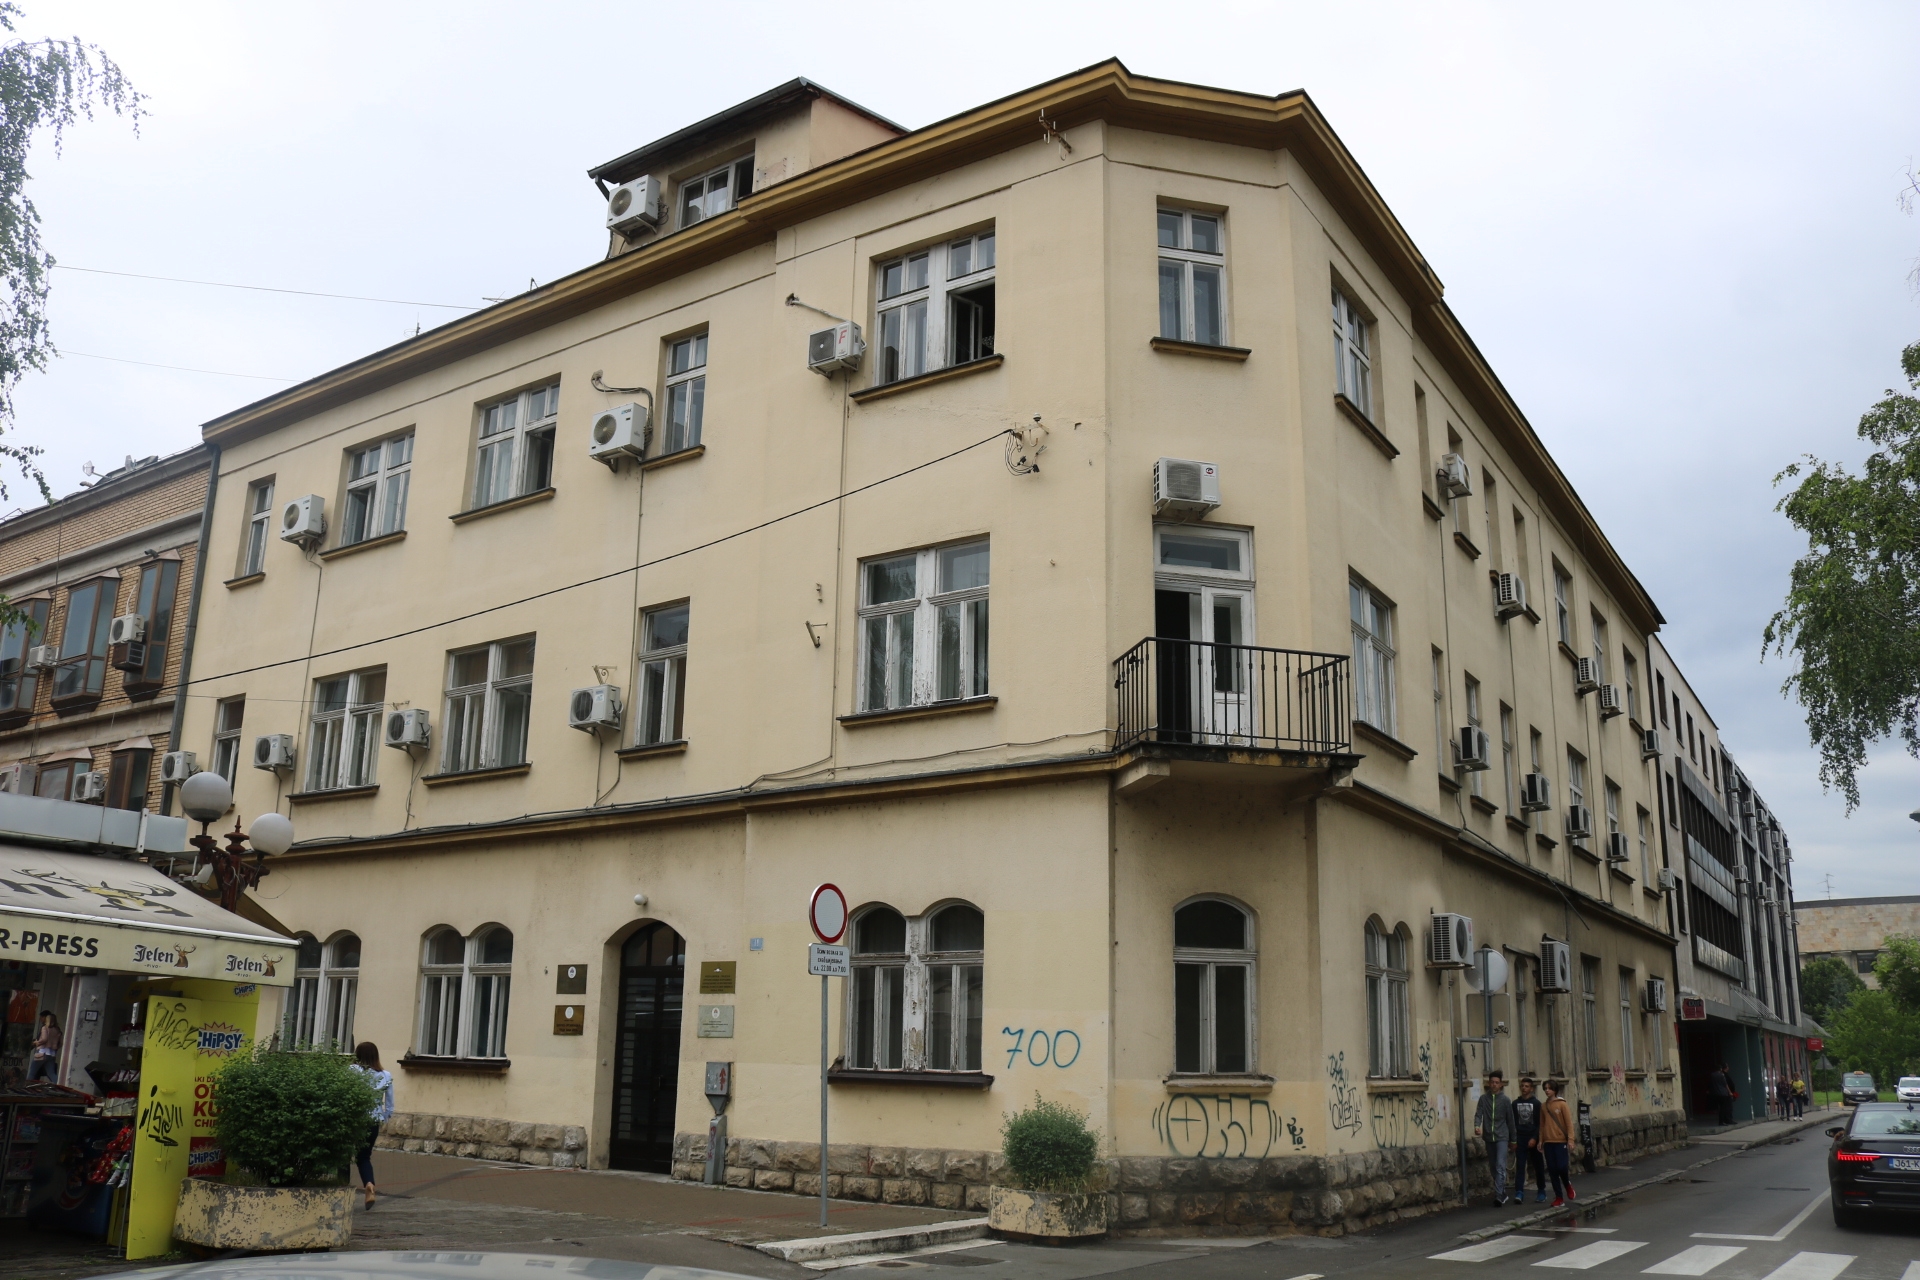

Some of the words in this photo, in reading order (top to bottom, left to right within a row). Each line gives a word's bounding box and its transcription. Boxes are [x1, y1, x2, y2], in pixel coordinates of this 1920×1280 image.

[132, 944, 174, 963] Jelen
[224, 954, 262, 973] Jelen
[1002, 1026, 1081, 1070] 700
